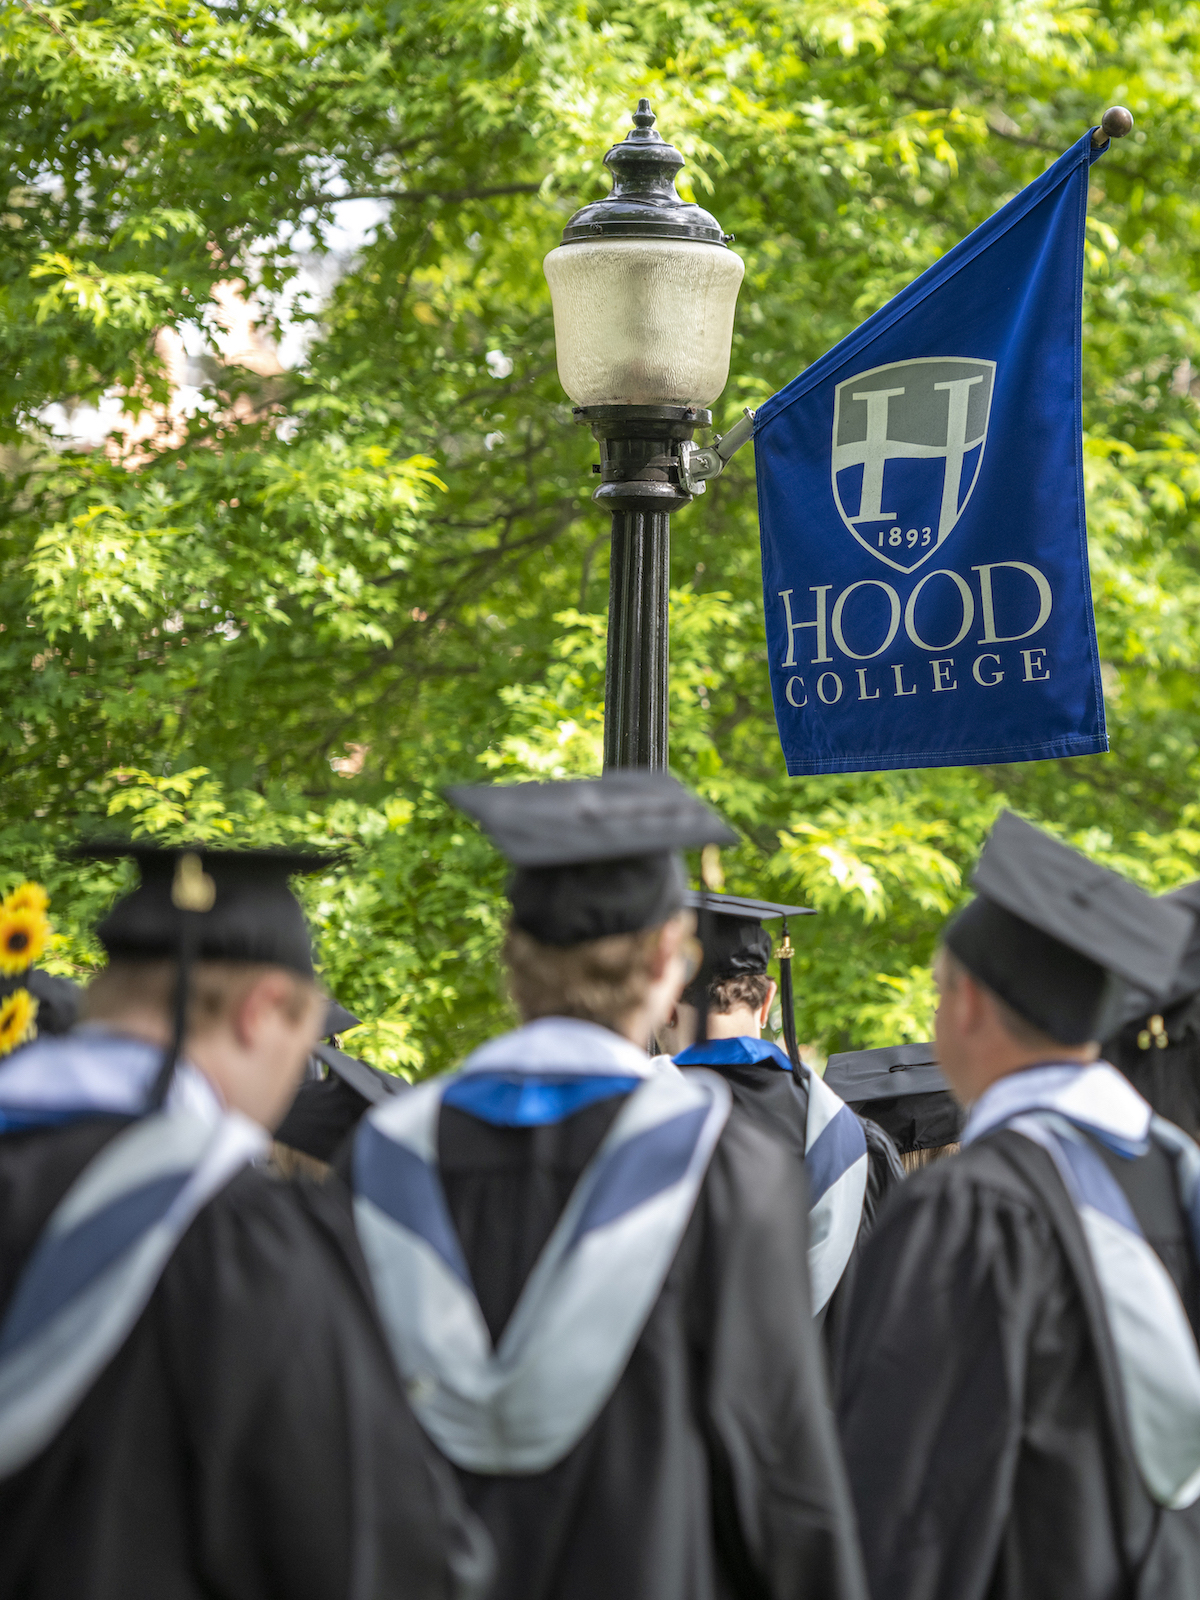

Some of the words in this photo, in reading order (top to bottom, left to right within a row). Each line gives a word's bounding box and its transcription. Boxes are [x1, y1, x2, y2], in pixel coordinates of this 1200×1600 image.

[846, 374, 985, 543] H
[878, 525, 932, 549] 1893
[778, 560, 1053, 668] HOOD
[785, 648, 1051, 708] COLLEGE
